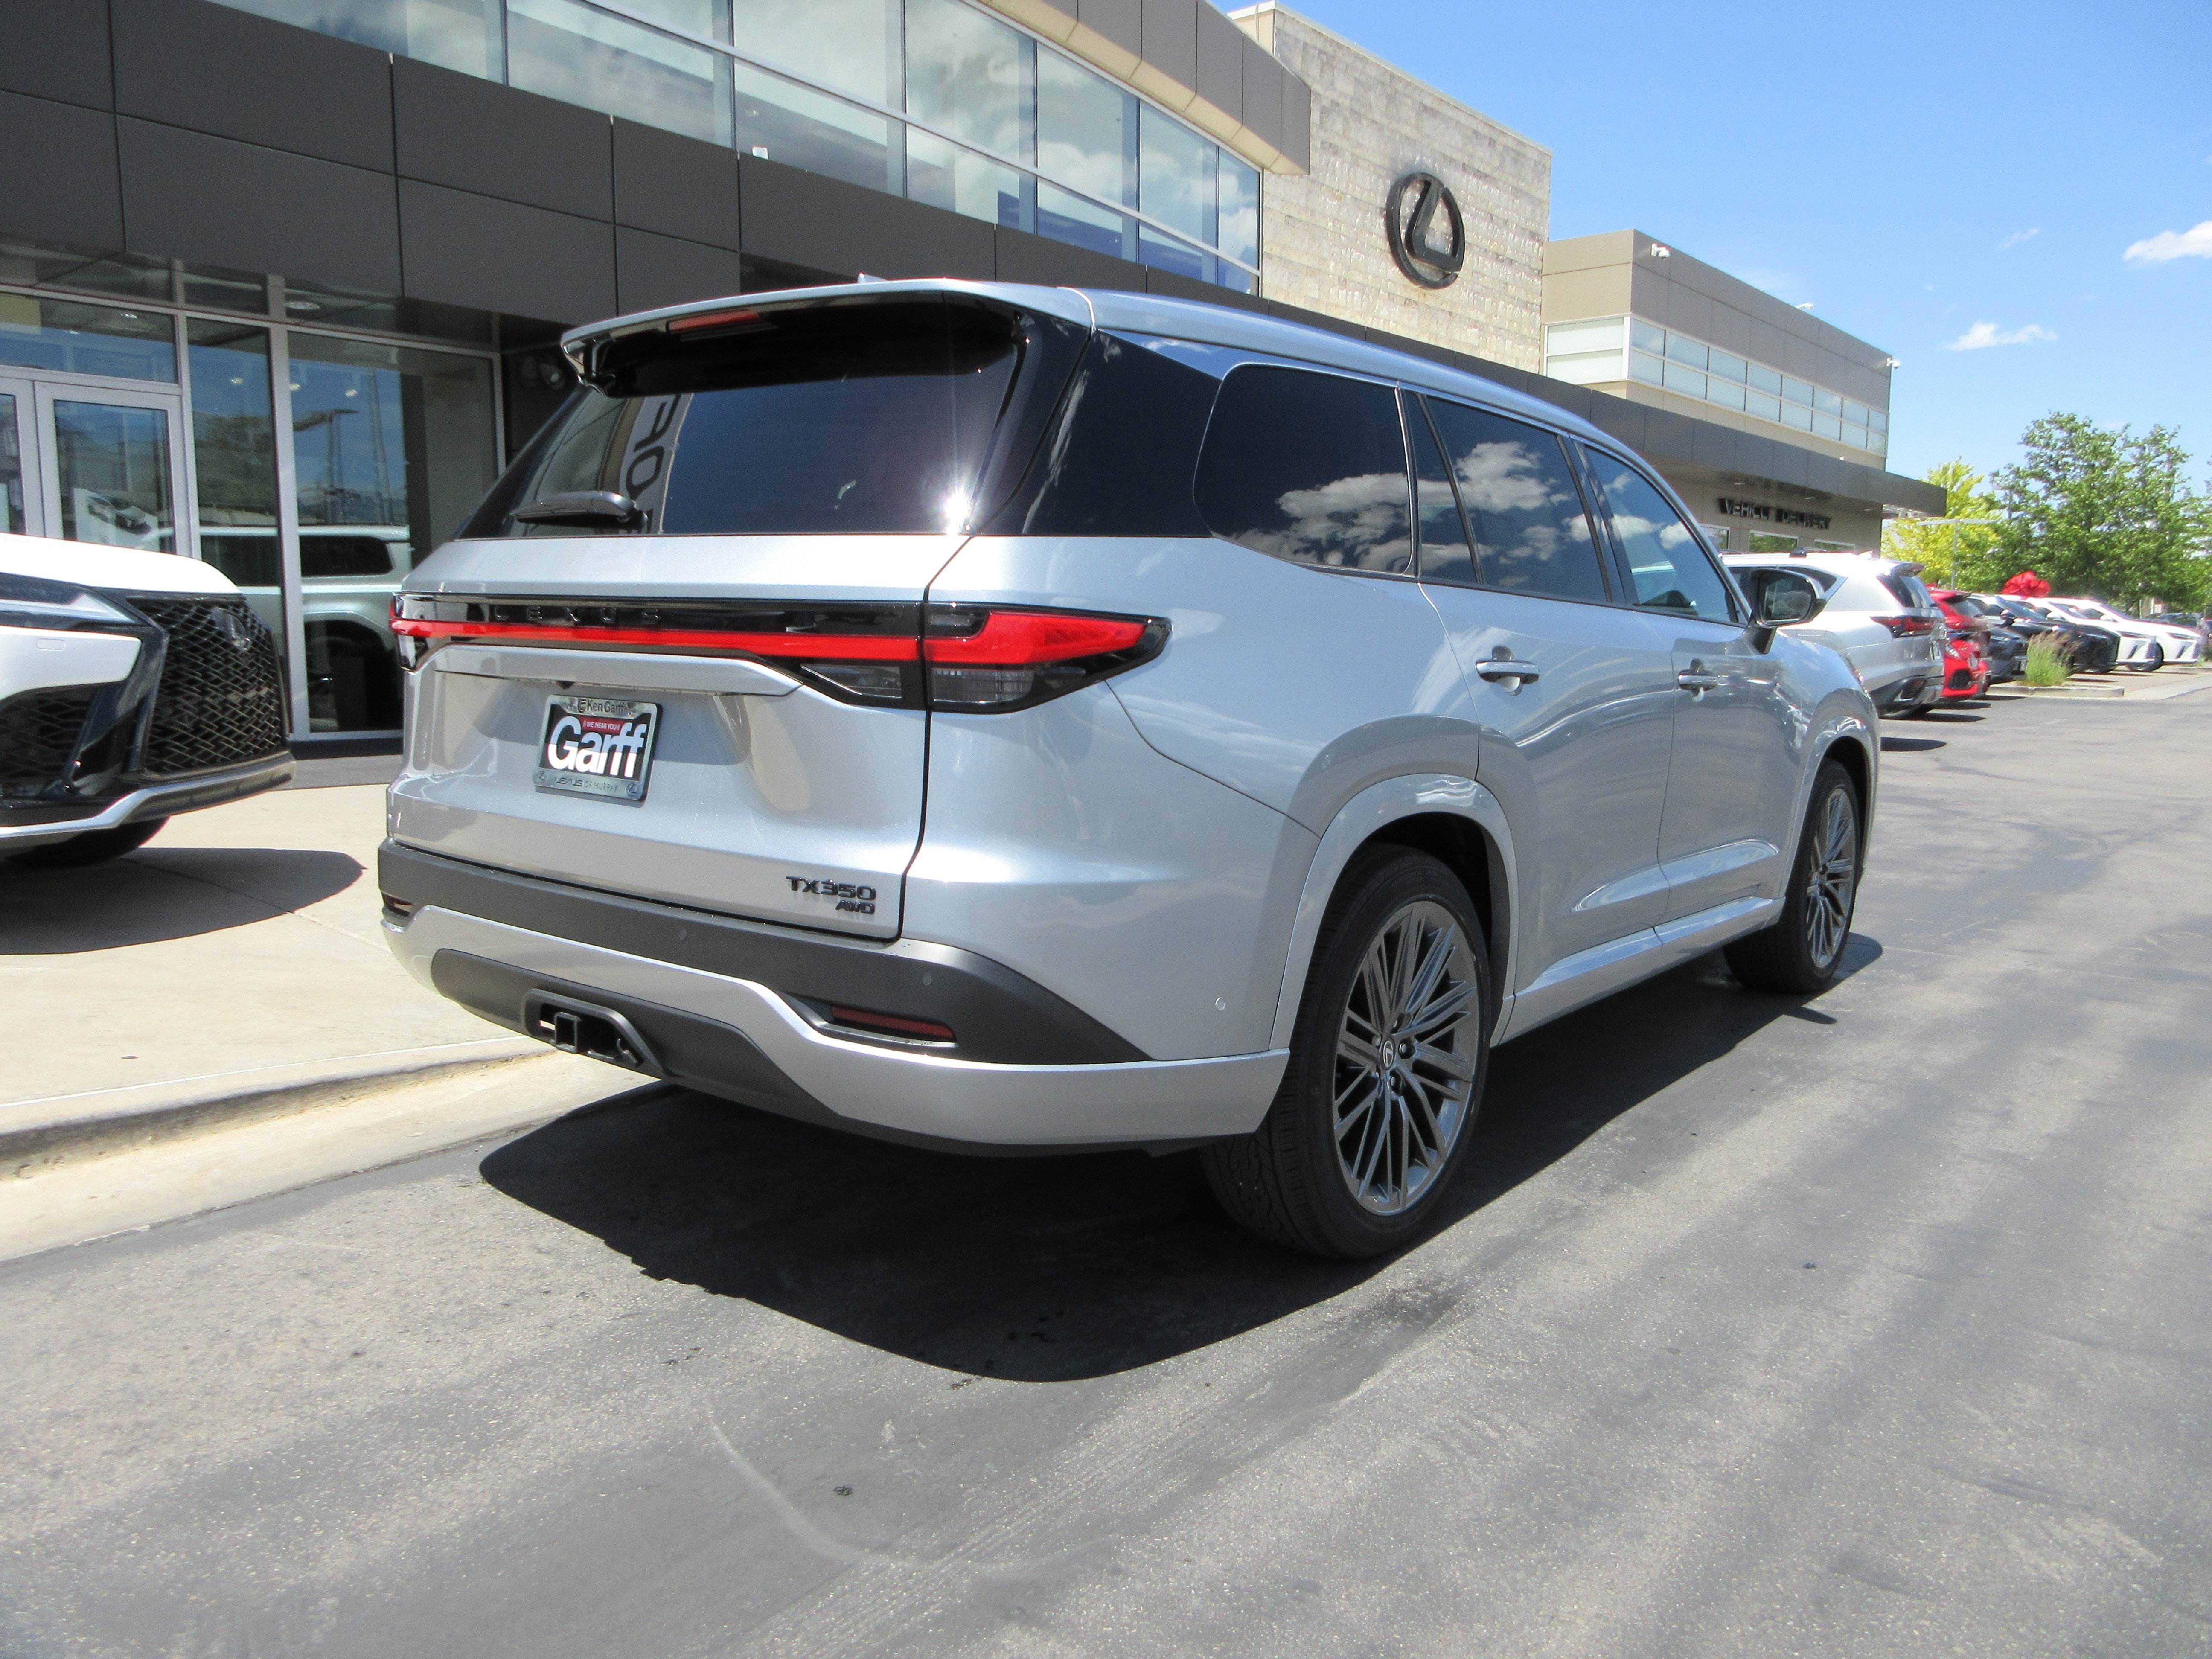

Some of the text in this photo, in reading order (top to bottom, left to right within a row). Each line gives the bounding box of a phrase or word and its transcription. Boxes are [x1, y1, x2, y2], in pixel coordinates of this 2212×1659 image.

[494, 605, 661, 625] LEXUS
[587, 699, 625, 714] Ken Garff
[548, 715, 647, 777] Garff
[556, 777, 583, 787] LEXUS
[835, 899, 875, 914] AWD
